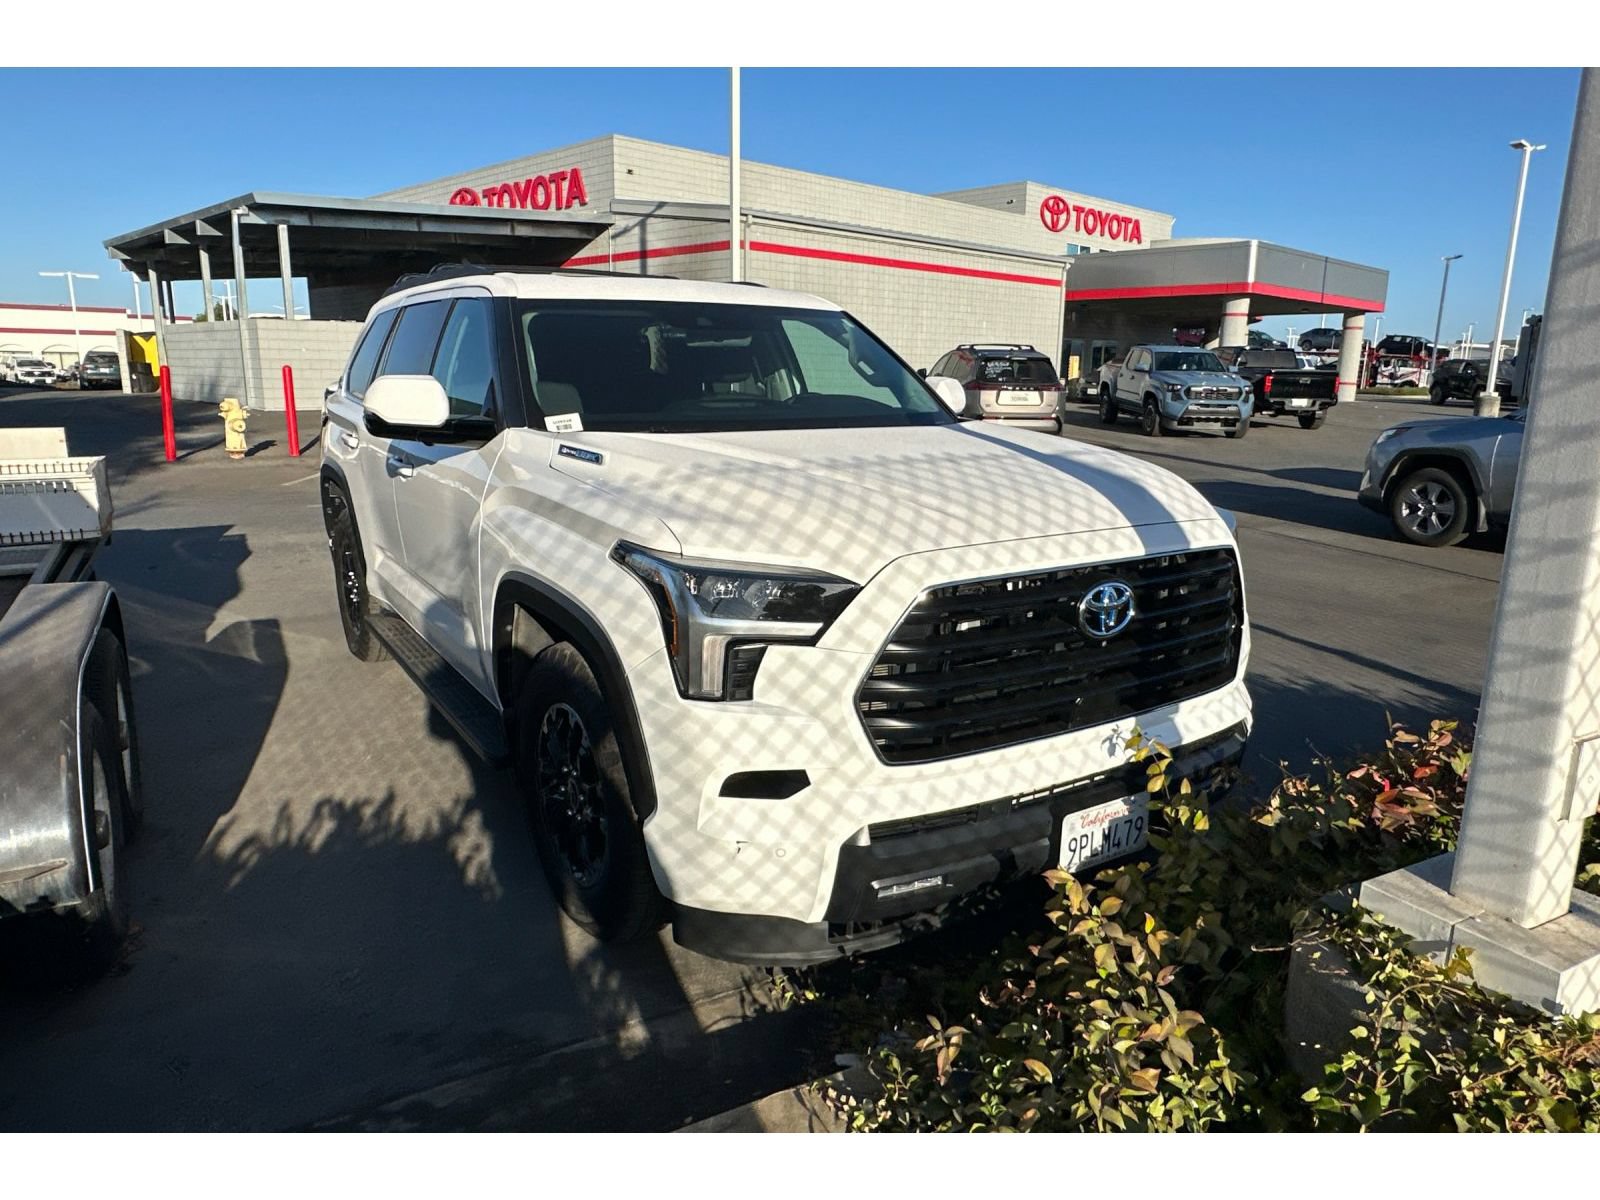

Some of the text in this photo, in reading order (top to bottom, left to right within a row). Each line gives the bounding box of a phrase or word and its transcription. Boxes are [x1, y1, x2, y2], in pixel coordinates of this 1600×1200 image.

[482, 167, 588, 211] TOYOTA
[1073, 205, 1142, 244] TOYOTA
[1081, 804, 1131, 829] California
[1067, 816, 1144, 867] 9PLM479
